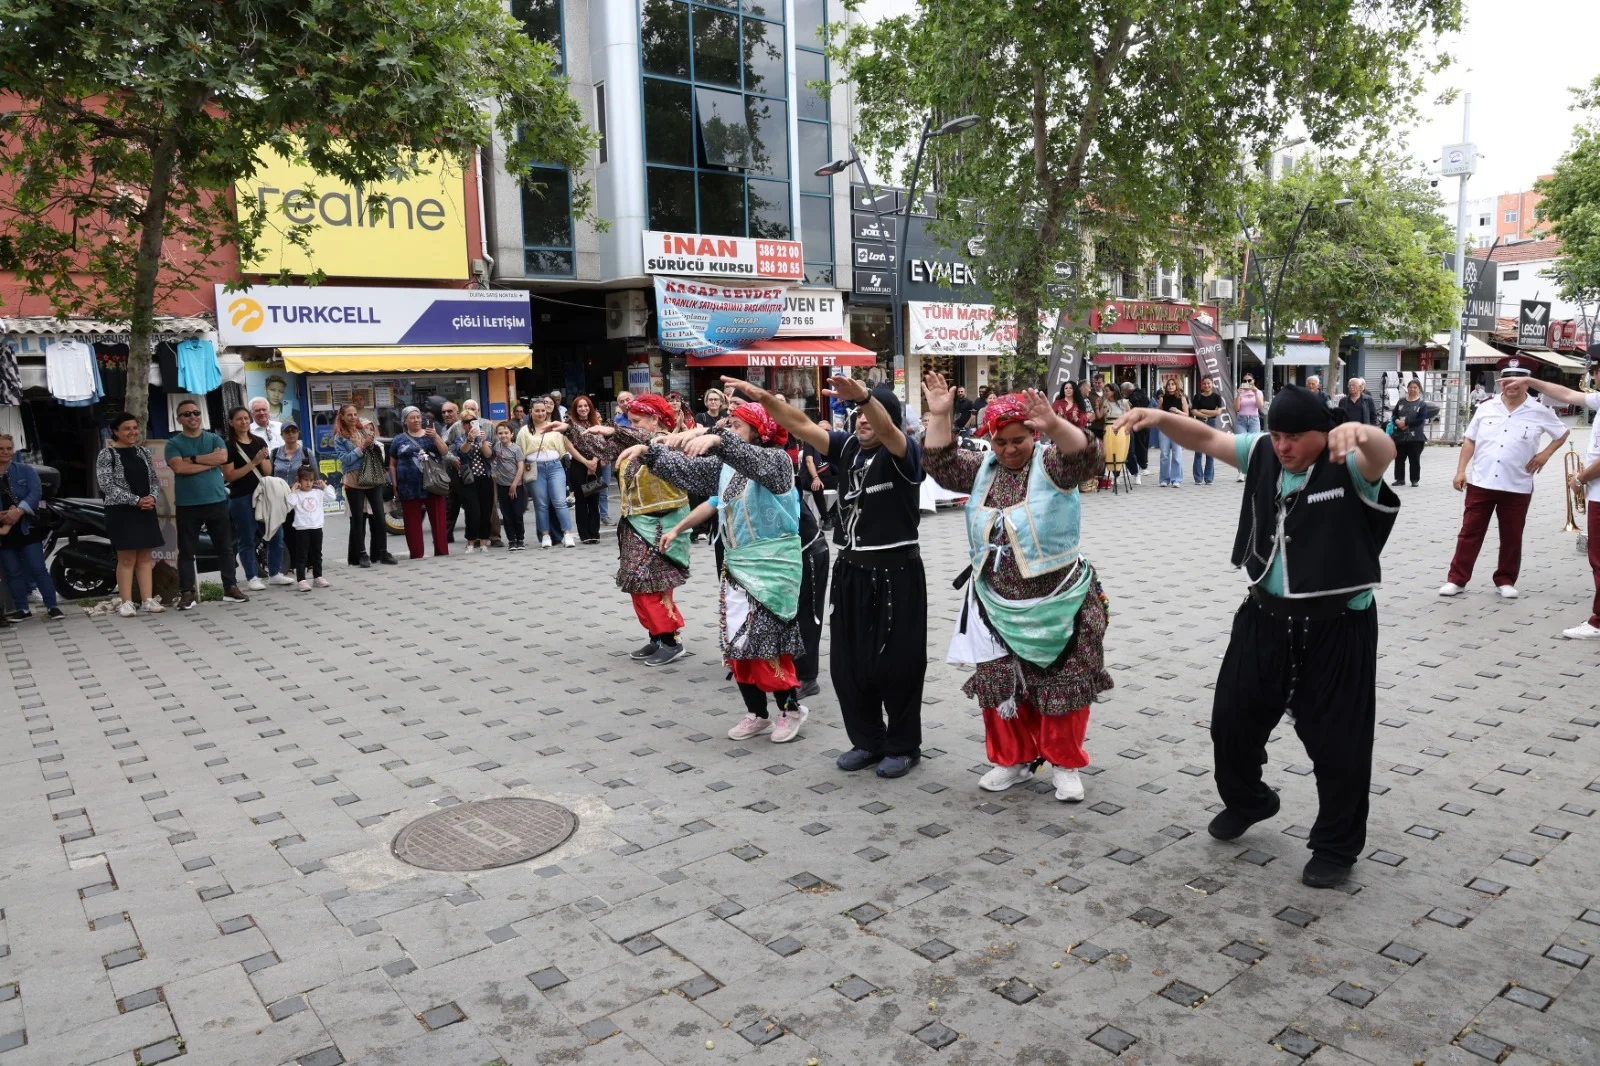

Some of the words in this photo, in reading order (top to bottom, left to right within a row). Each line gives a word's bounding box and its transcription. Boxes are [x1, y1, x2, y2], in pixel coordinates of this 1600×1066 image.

[258, 186, 446, 231] realme
[759, 244, 774, 256] 386
[777, 245, 787, 257] 22
[789, 246, 799, 258] 00
[648, 256, 704, 271] SÜRÜCÜ
[709, 261, 753, 273] KURSU
[760, 261, 775, 273] 386
[777, 262, 787, 273] 20
[790, 262, 800, 274] 55
[911, 259, 977, 285] EYMEN
[665, 281, 718, 297] KASAP
[722, 289, 782, 299] CEVDET
[819, 297, 835, 312] ET
[922, 305, 953, 319] TÜM
[267, 305, 381, 324] TURKCELL
[781, 317, 791, 325] 29
[793, 317, 802, 325] 76
[804, 317, 814, 325] 65
[452, 315, 480, 330] ÇİĞLİ
[483, 315, 525, 330] İLETİŞİM
[747, 354, 776, 366] İNAN
[780, 354, 818, 366] GÜVEN
[822, 357, 836, 366] ET
